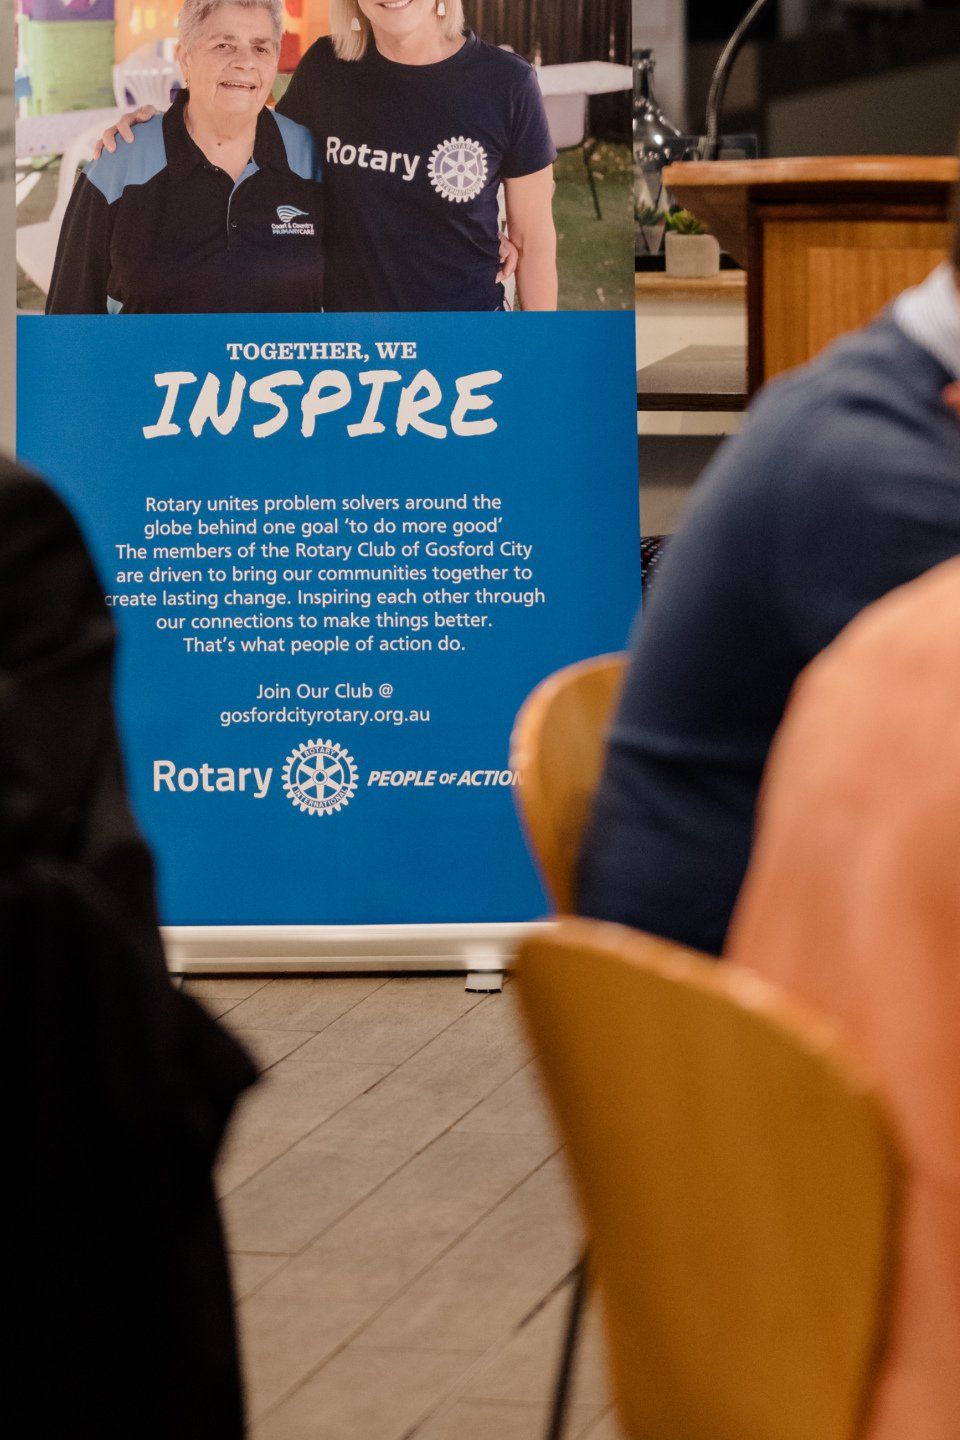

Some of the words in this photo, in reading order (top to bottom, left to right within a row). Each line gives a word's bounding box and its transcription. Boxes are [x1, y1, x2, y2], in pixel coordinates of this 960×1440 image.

[326, 136, 420, 181] Rotary
[226, 341, 370, 363] TOGETHER,
[375, 341, 417, 359] WE
[142, 368, 503, 440] INSPIRE
[145, 497, 202, 516] Rotary
[207, 495, 259, 511] unites
[264, 494, 337, 515] problem
[341, 494, 400, 510] solvers
[405, 493, 467, 510] around
[472, 493, 502, 510] the
[143, 519, 193, 540] globe
[198, 518, 257, 535] behind
[262, 522, 296, 535] one
[301, 517, 338, 538] goal
[373, 517, 397, 534] do
[402, 521, 447, 534] more
[115, 543, 148, 560] The
[153, 542, 232, 559] members
[237, 541, 256, 558] of
[260, 541, 290, 558] the
[295, 542, 352, 561] Rotary
[357, 541, 396, 557] Club
[401, 540, 420, 557] of
[425, 540, 494, 557] Gosford
[499, 540, 533, 560] City
[116, 571, 144, 583] are
[149, 566, 203, 583] driven
[207, 567, 227, 582] to
[232, 565, 277, 586] bring
[282, 569, 313, 582] our
[317, 564, 427, 581] communities
[431, 564, 509, 584] together
[513, 566, 533, 580] to
[104, 592, 157, 607] create
[162, 589, 219, 610] lasting
[224, 589, 291, 609] change.
[298, 588, 371, 608] Inspiring
[376, 588, 417, 604] each
[422, 587, 470, 604] other
[474, 587, 545, 608] through
[156, 617, 186, 630] our
[191, 612, 294, 629] connections
[298, 614, 318, 628] to
[323, 611, 371, 628] make
[375, 611, 429, 632] things
[434, 611, 492, 628] better.
[240, 636, 286, 652] what
[291, 635, 350, 656] people
[355, 635, 374, 652] of
[379, 635, 432, 651] action
[437, 634, 465, 651] do.
[256, 683, 291, 699] Join
[296, 683, 330, 699] Our
[334, 682, 374, 699] Club
[378, 683, 394, 699] @
[220, 706, 430, 727] gosfordcityrotary.org.au
[303, 747, 337, 755] ROTARY
[153, 759, 273, 799] Rotary
[367, 770, 437, 787] PEOPLE
